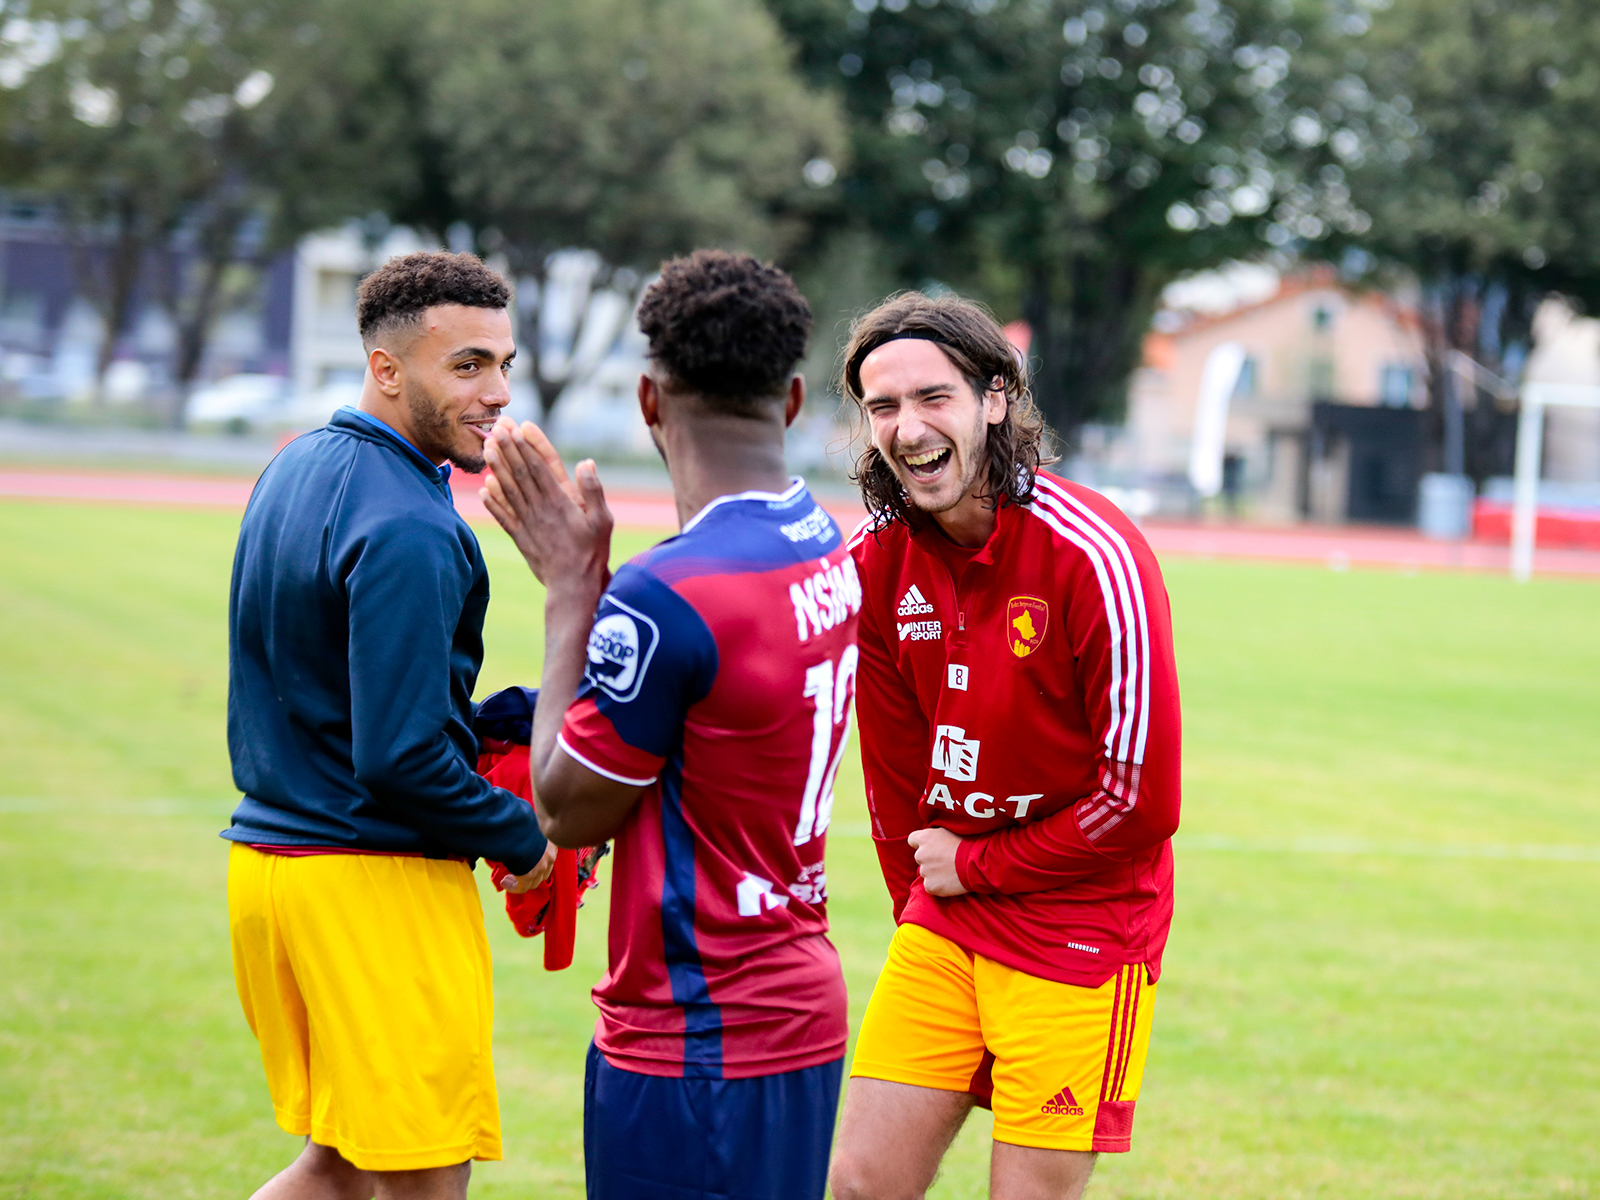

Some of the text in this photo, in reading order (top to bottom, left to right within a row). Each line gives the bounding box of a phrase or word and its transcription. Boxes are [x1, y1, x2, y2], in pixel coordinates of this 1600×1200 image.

[897, 603, 934, 616] adidas
[910, 621, 941, 632] INTER
[911, 631, 941, 641] SPORT
[955, 668, 963, 686] 8
[1067, 942, 1100, 955] AEROREADY
[1041, 1105, 1084, 1117] adidas
